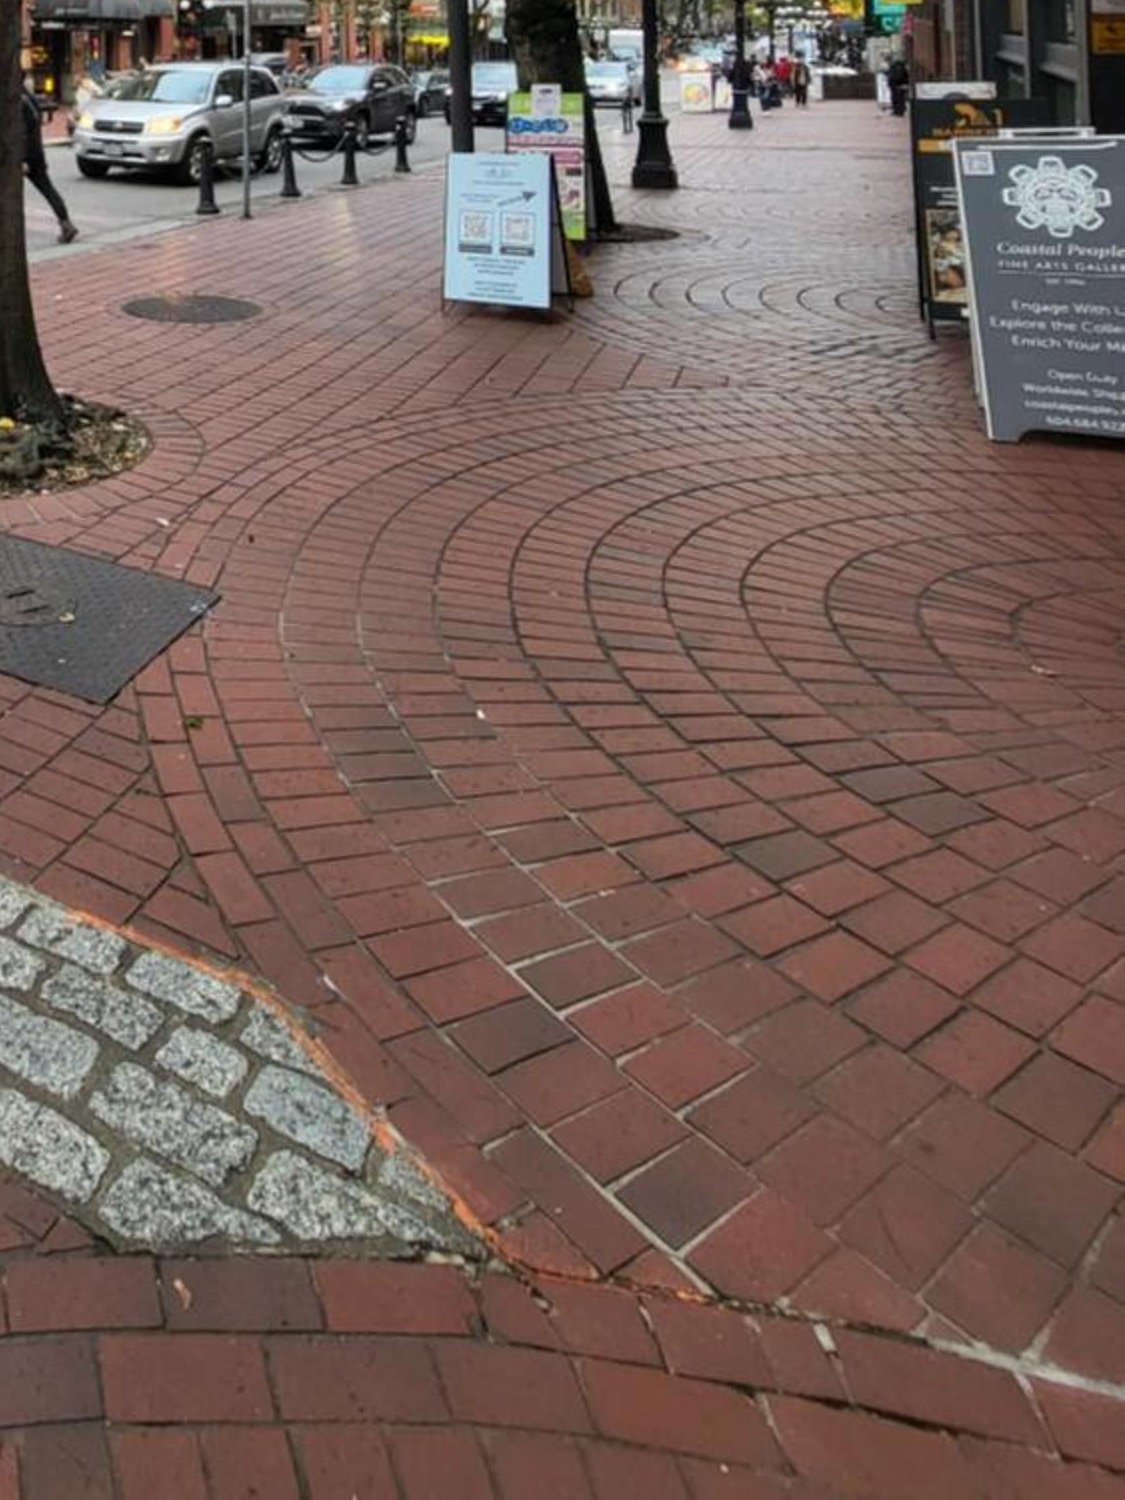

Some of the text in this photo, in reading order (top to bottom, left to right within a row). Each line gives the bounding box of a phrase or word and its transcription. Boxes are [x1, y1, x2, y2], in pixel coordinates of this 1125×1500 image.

[996, 242, 1062, 256] Coastal
[1036, 261, 1069, 270] ARTS
[1011, 299, 1069, 316] Engage
[1072, 302, 1111, 316] With
[989, 315, 1047, 331] Explore
[1050, 320, 1077, 331] the
[1011, 334, 1062, 349] Enrich
[1063, 338, 1100, 352] Your
